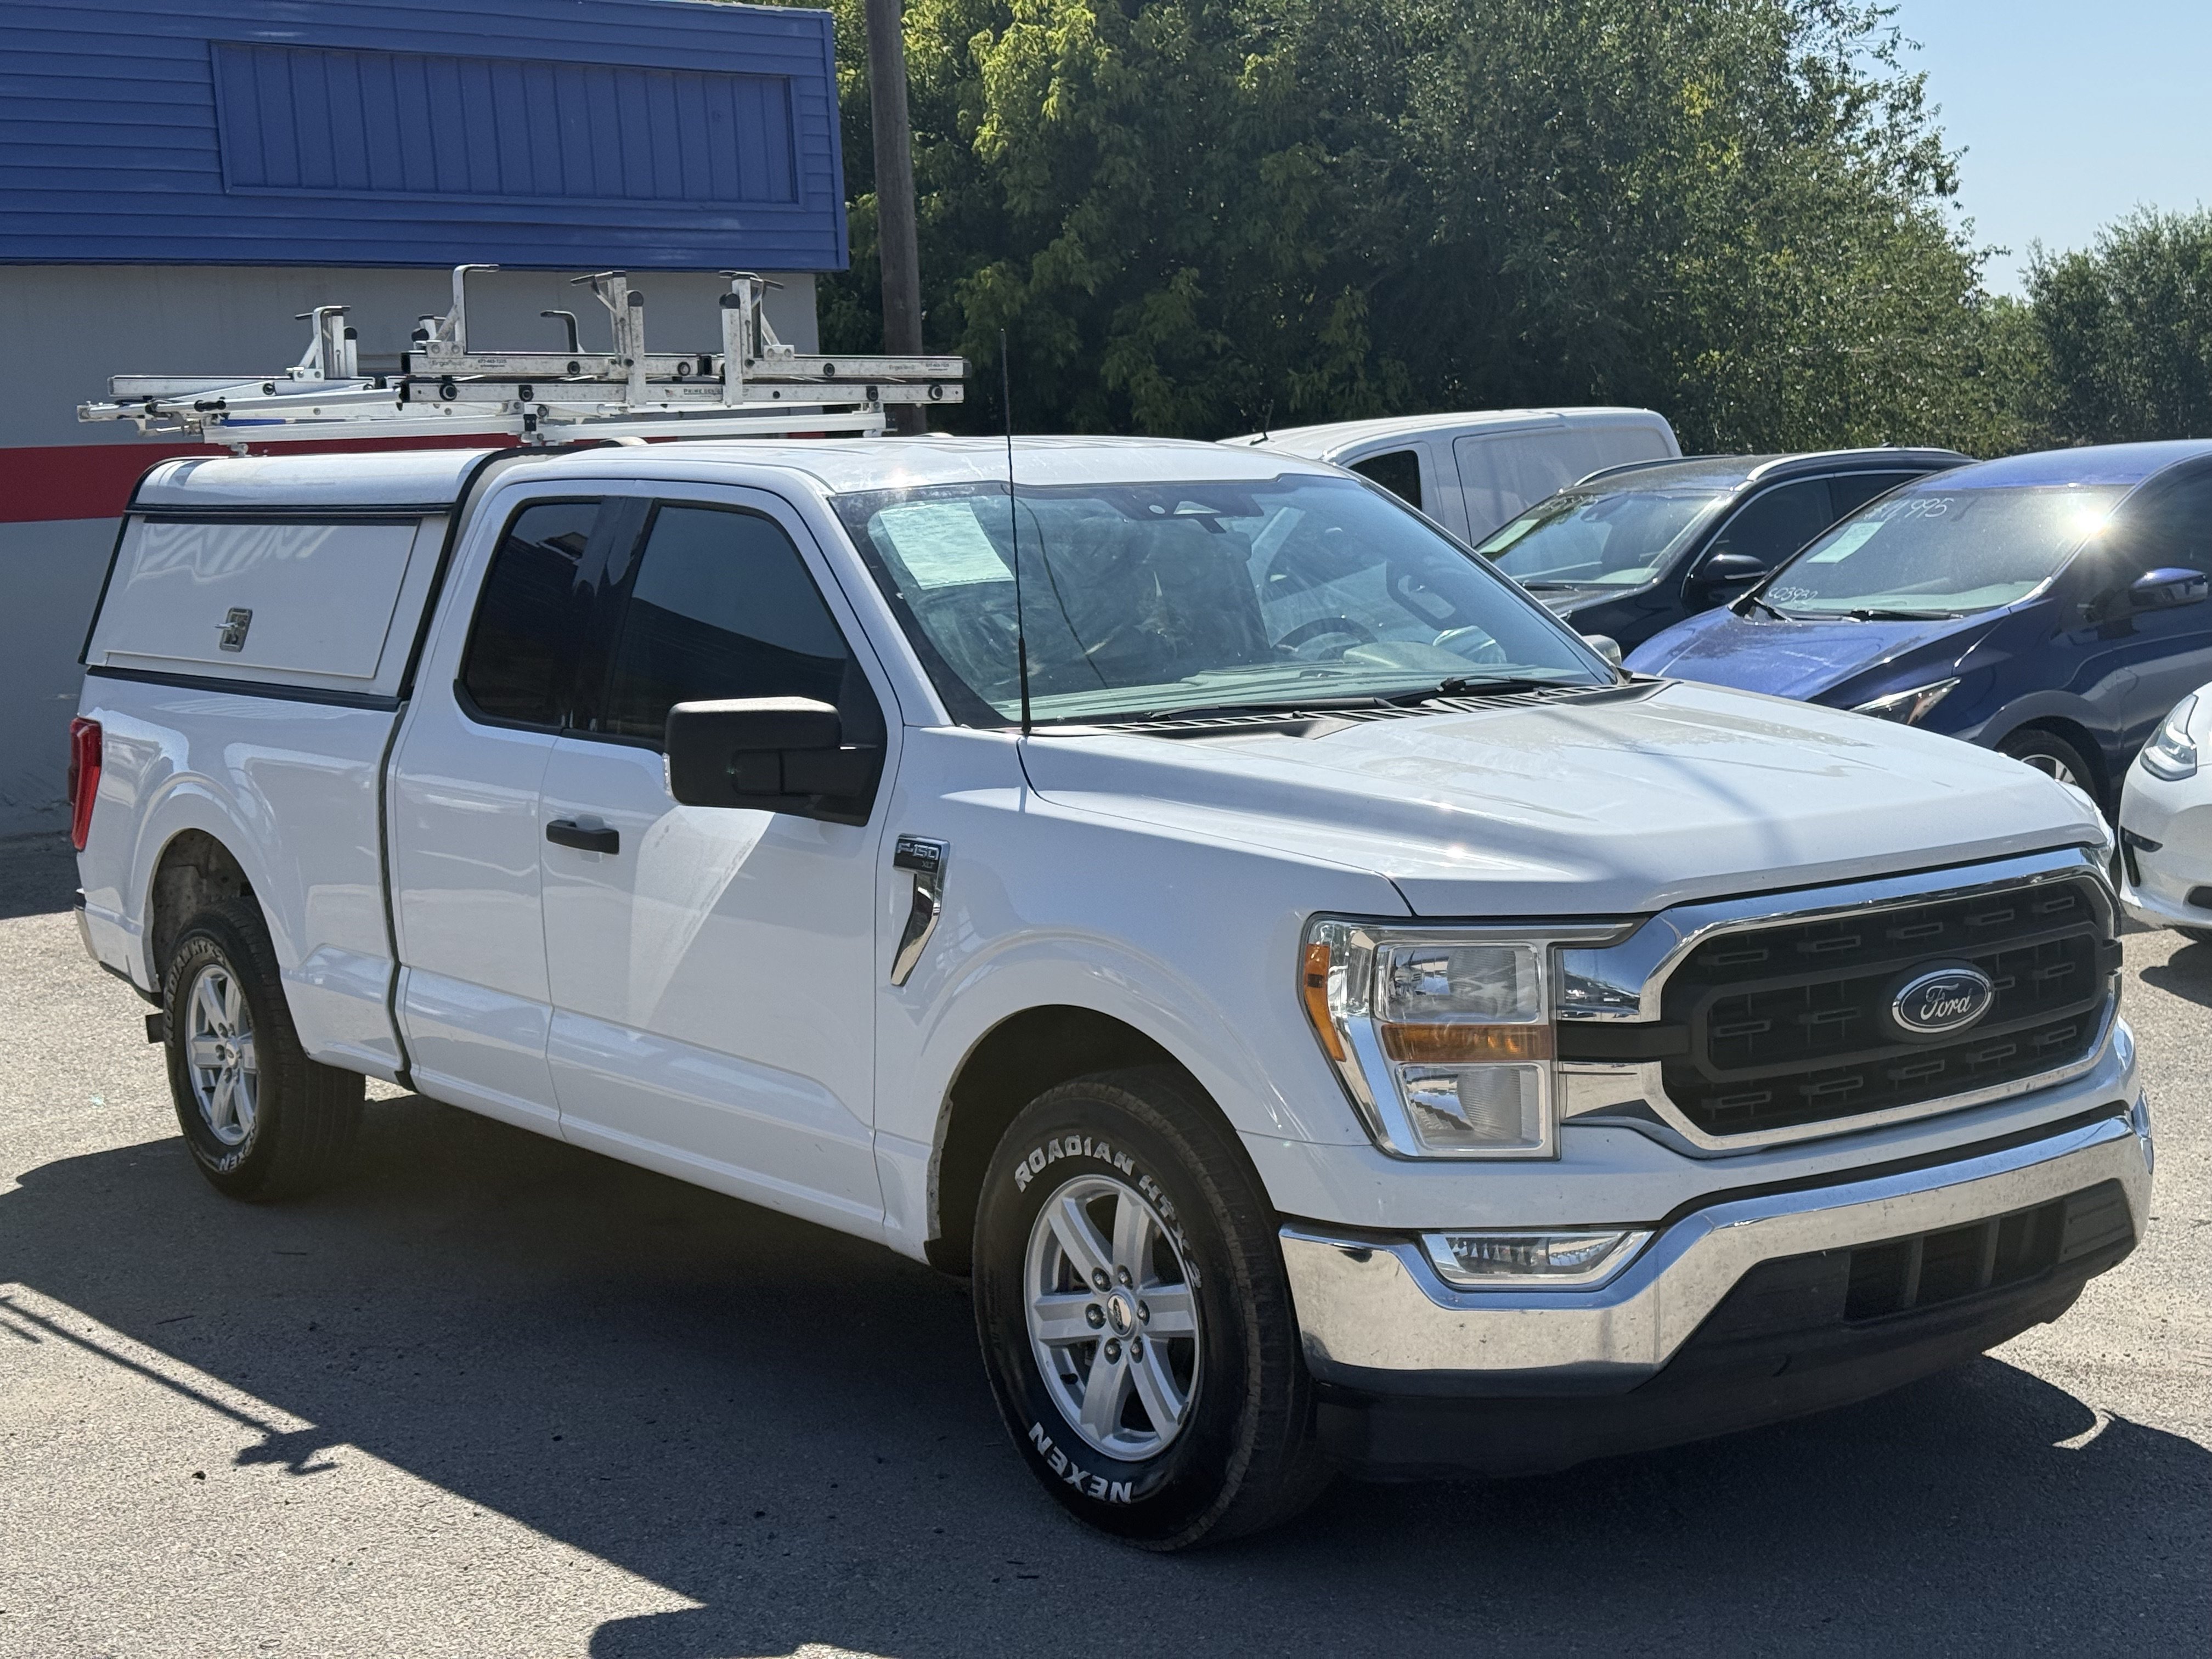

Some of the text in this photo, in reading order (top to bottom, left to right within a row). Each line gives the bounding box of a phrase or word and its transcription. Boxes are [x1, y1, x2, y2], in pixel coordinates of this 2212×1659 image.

[897, 843, 939, 861] F-150
[922, 860, 935, 868] XLT
[163, 945, 192, 1047] ROADIAN
[1921, 983, 1973, 1020] Ford
[1015, 1135, 1135, 1193] ROADIAN
[1028, 1421, 1132, 1504] NEXEN
